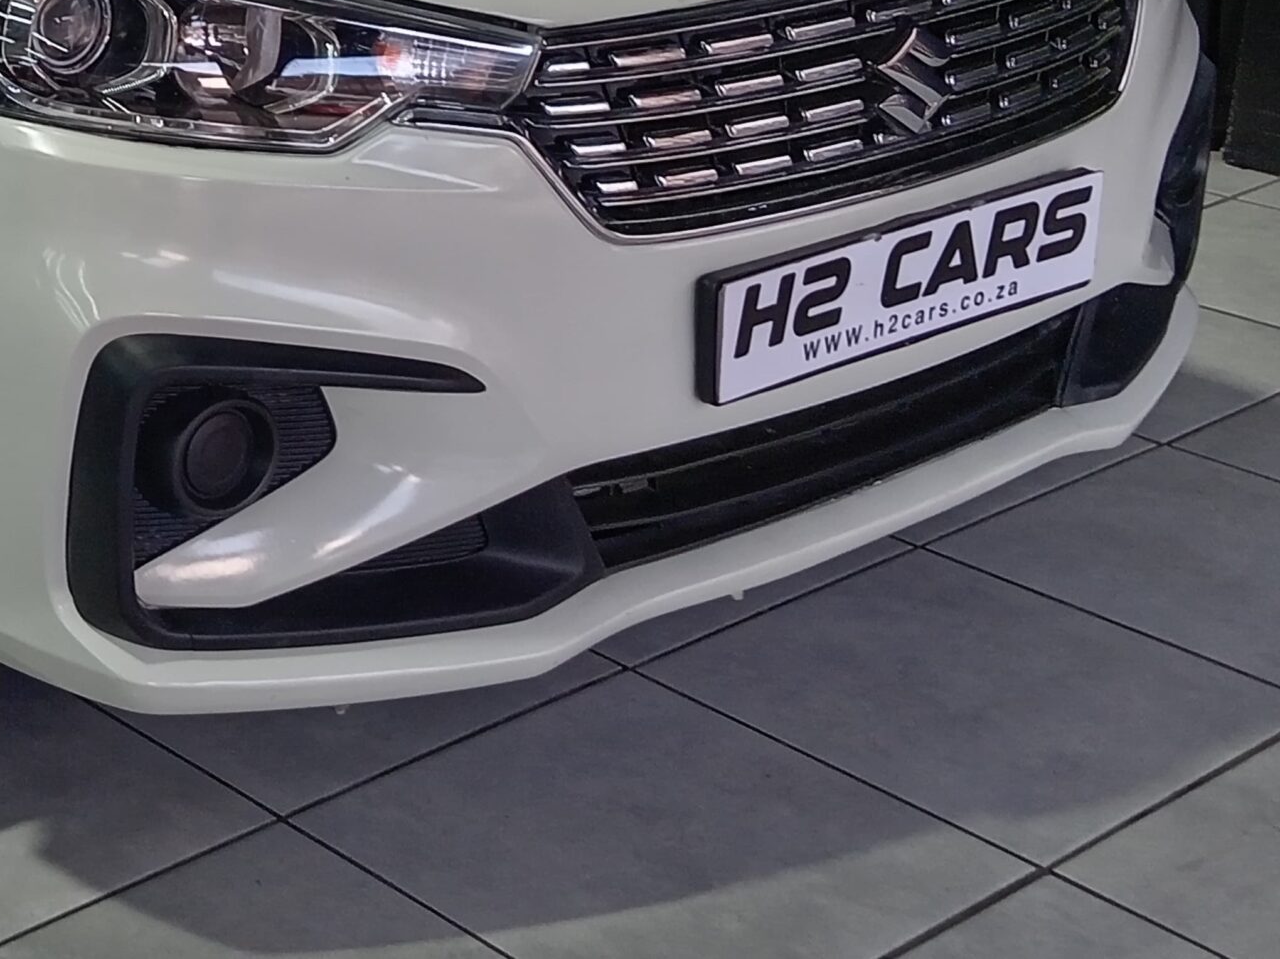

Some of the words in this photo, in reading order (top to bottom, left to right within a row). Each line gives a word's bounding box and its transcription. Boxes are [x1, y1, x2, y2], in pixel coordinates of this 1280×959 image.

[734, 256, 851, 359] H2
[880, 185, 1093, 308] CARS
[803, 280, 1019, 361] www.h2cars.co.za
